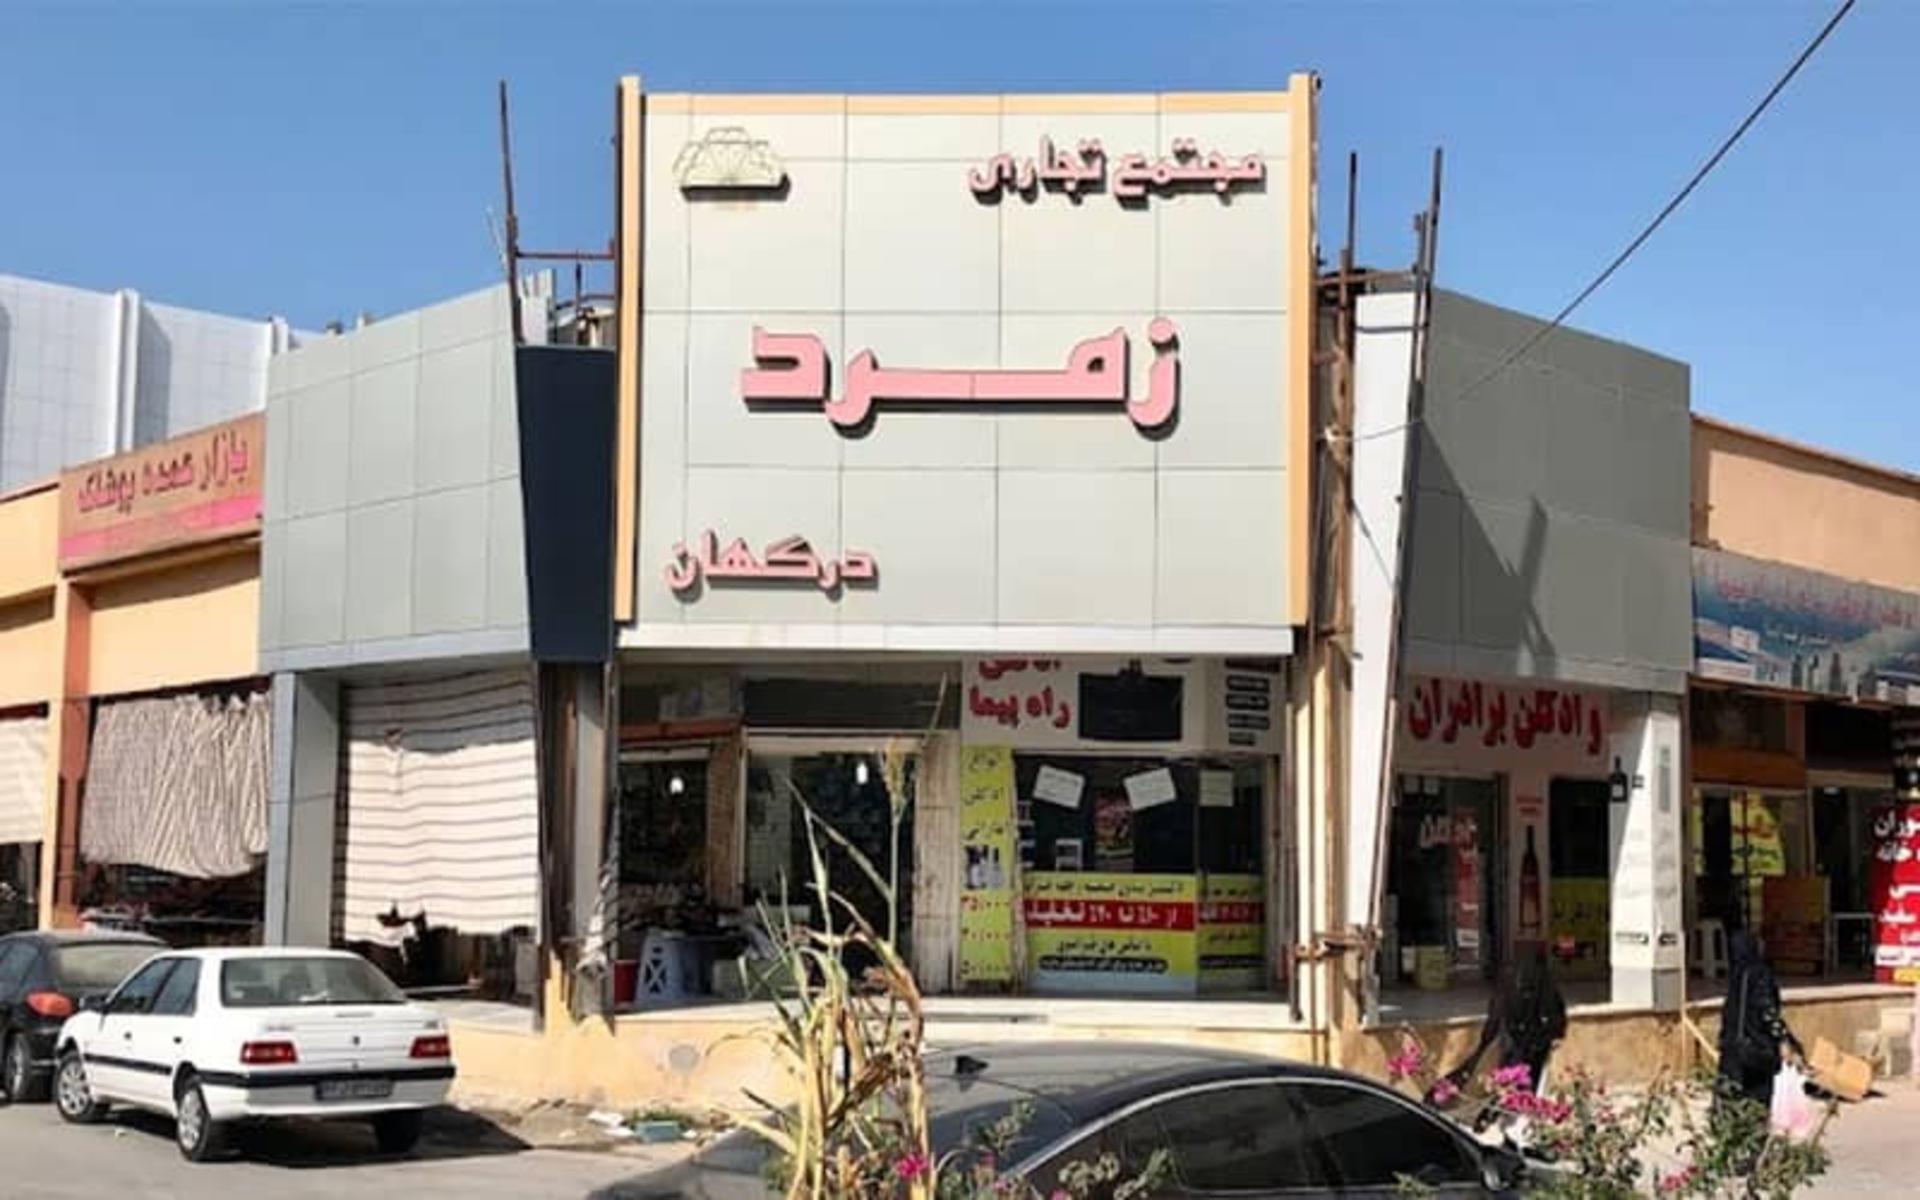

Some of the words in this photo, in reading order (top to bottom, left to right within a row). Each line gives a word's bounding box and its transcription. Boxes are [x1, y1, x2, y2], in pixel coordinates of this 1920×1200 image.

[968, 134, 1105, 204] تجاری
[1112, 137, 1266, 208] مجتمع
[741, 316, 1180, 439] زمرد
[77, 466, 136, 514] پوشاک
[142, 452, 195, 496] عمده
[200, 428, 249, 491] بازار
[968, 685, 1021, 730] پیما
[1025, 685, 1070, 730] راه
[1408, 677, 1507, 747] برادران
[1513, 690, 1583, 749] ادکلن
